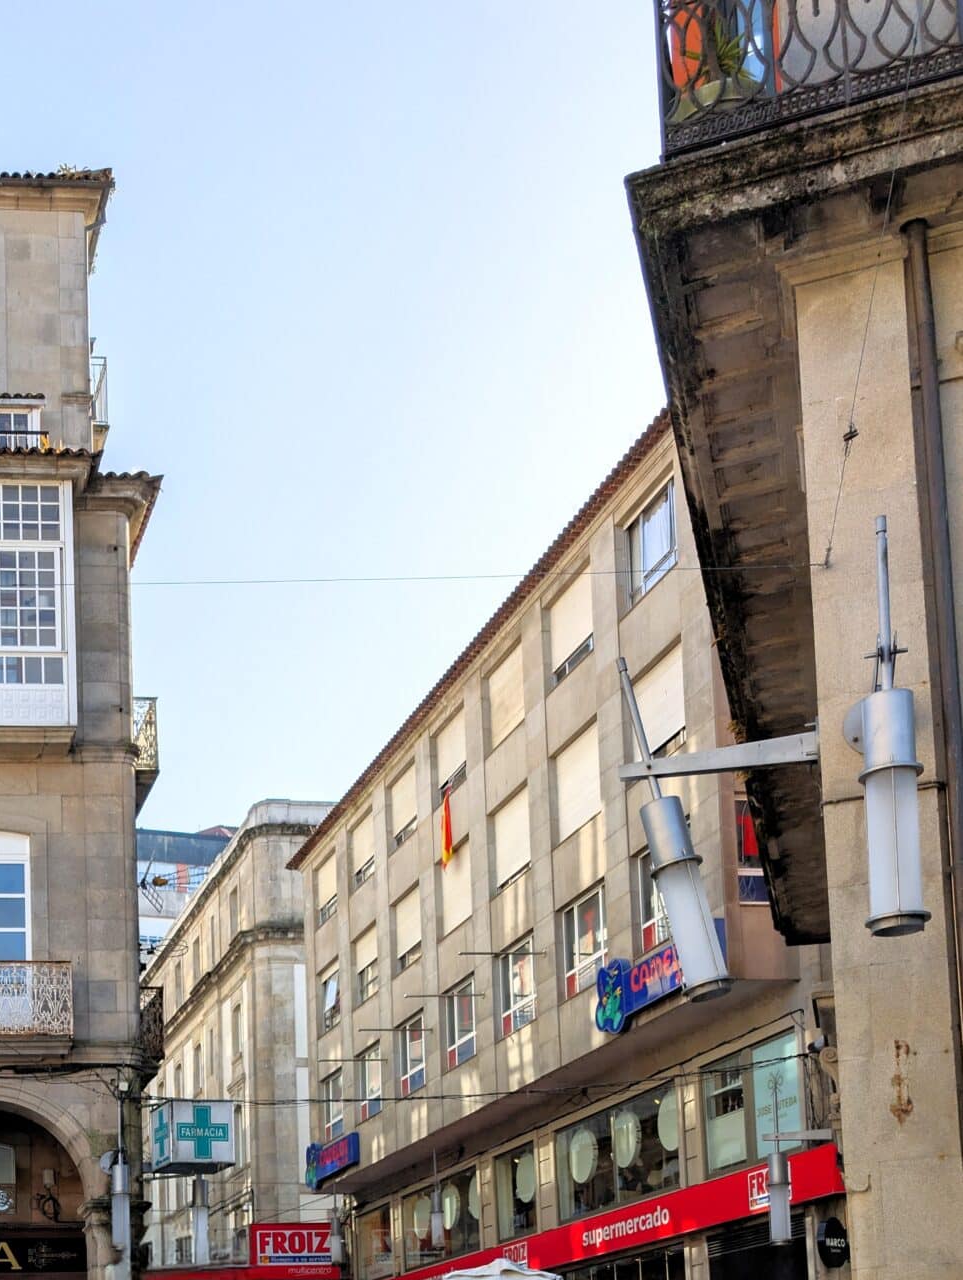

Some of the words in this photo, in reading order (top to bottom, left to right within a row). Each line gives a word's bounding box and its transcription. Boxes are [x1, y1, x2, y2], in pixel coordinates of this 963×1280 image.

[181, 1127, 224, 1137] FARMACIA
[582, 1205, 670, 1248] supermercado
[259, 1231, 331, 1254] FROIZ
[825, 1237, 846, 1248] MARCO
